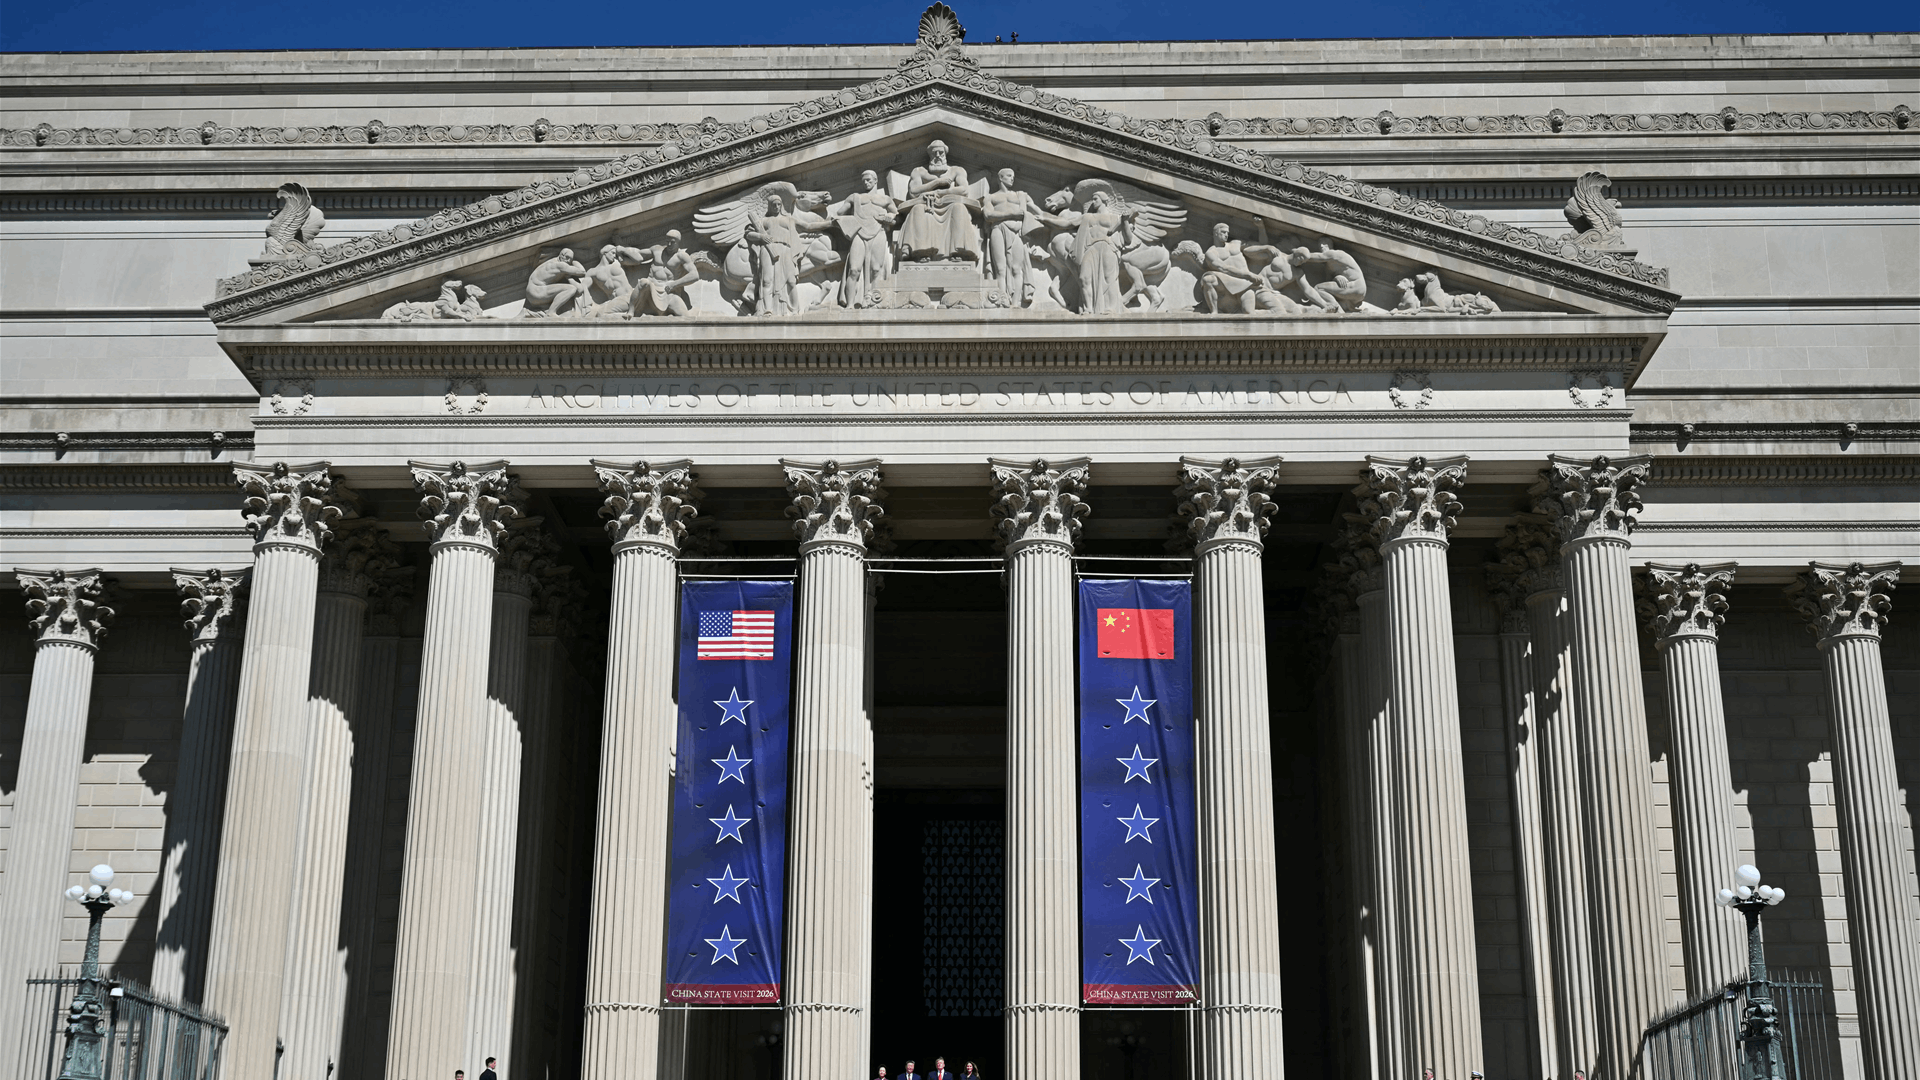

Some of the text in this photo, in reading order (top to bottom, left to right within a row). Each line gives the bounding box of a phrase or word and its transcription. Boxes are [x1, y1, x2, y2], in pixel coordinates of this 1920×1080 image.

[525, 380, 1354, 409] ARCHIVES OF THE UNITED STATES OF AMERICA
[671, 989, 775, 998] CHINA STATE VISIT 2026
[1089, 989, 1194, 999] CHINA STATE VISIT 2026
